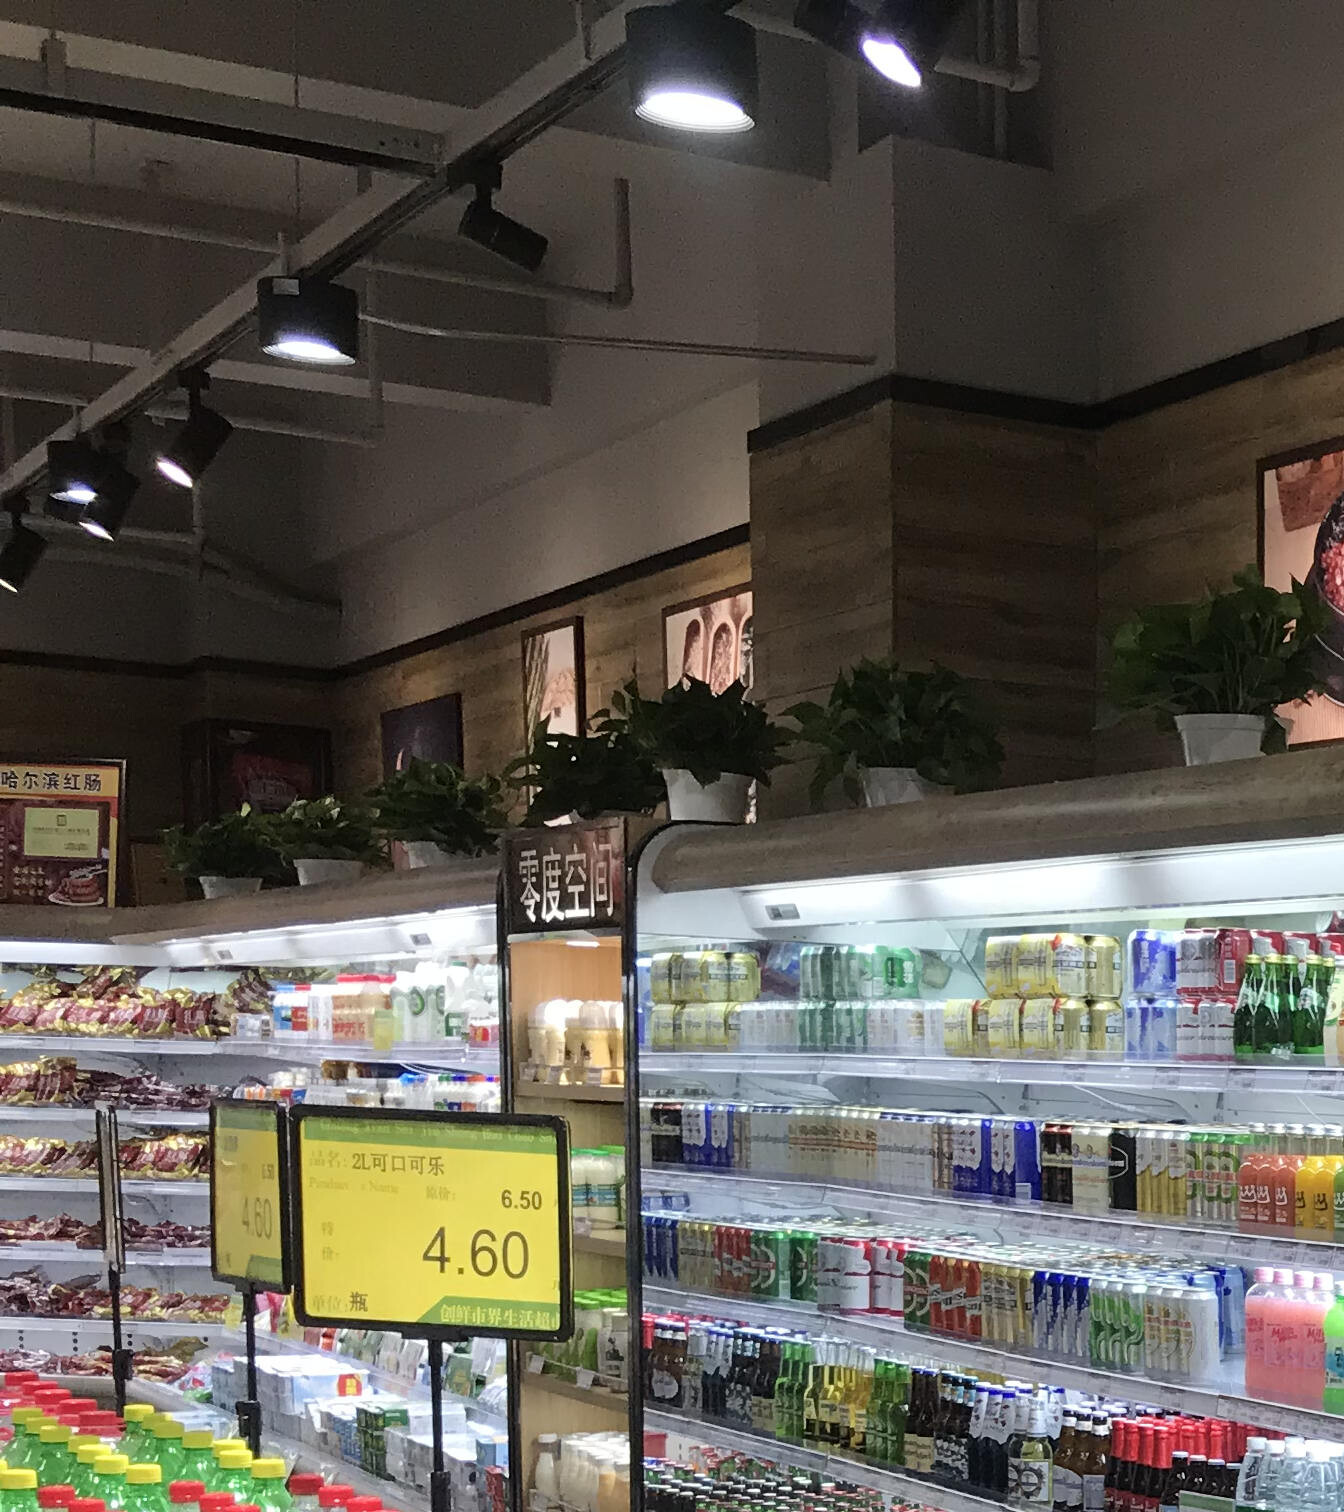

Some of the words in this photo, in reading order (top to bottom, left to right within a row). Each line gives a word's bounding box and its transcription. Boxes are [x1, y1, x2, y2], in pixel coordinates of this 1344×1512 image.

[1, 769, 102, 792] 哈尔滨红肠
[519, 842, 614, 923] 零度空间
[352, 1153, 445, 1176] 2L可口可乐
[501, 1189, 543, 1210] 6.50
[242, 1197, 273, 1239] 4.60
[422, 1226, 530, 1280] 4.60
[349, 1291, 368, 1313] 瓶
